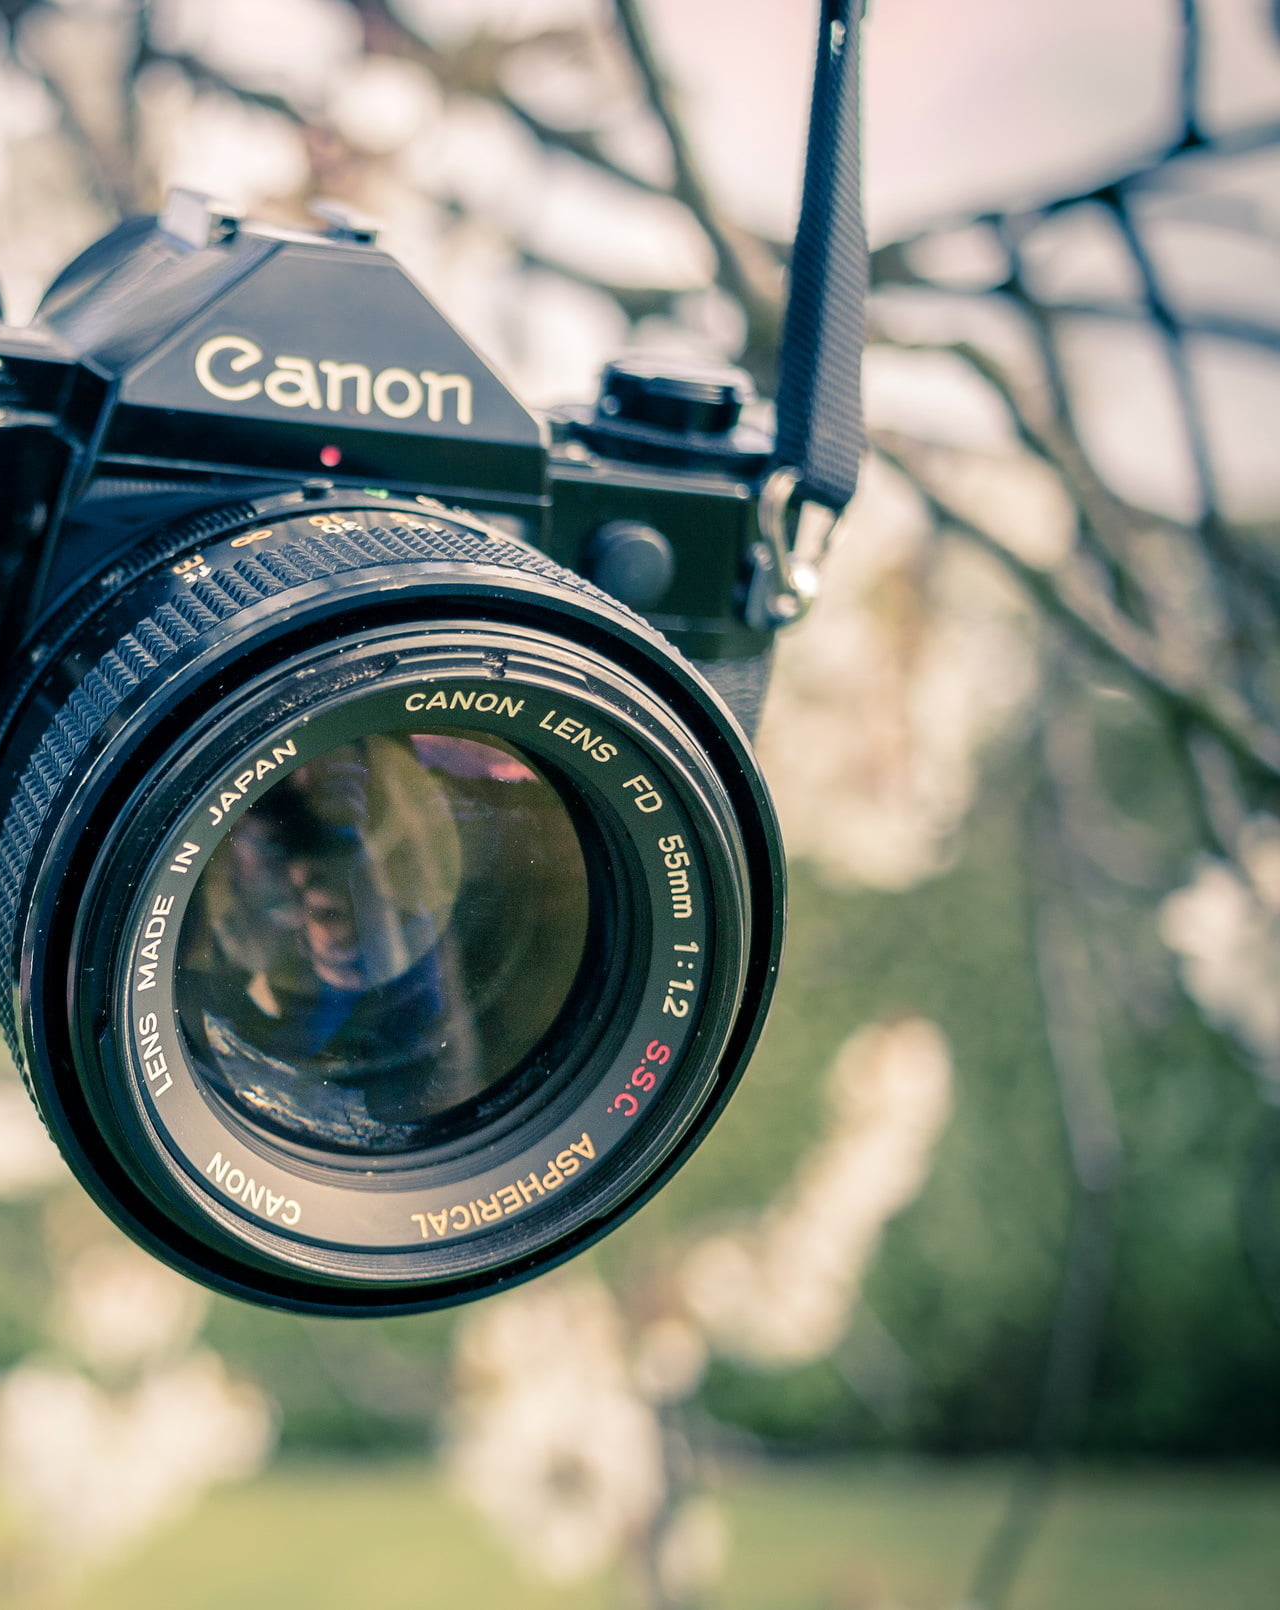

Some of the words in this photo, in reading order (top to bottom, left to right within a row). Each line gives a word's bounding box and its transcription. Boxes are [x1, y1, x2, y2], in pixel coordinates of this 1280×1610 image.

[195, 335, 472, 425] Canon
[404, 691, 525, 718] CANON
[538, 710, 618, 763] LENS
[209, 739, 297, 826] JAPAN
[622, 774, 663, 814] FD
[170, 841, 201, 874] IN
[658, 834, 693, 919] 55mm
[137, 894, 175, 992] MADE
[138, 1012, 174, 1097] LENS
[606, 1040, 671, 1117] S.S.C.
[206, 1151, 302, 1226] CANON
[410, 1132, 597, 1239] ASPHERICAL
